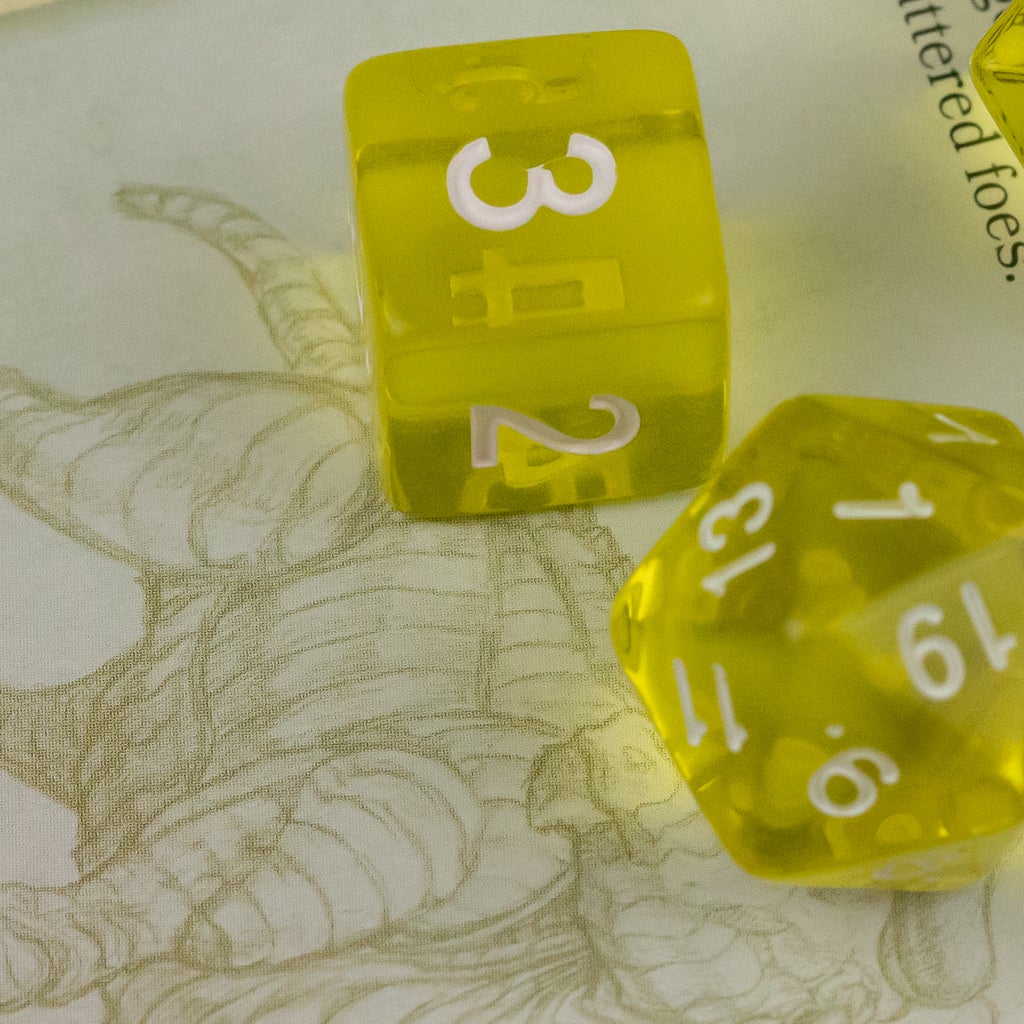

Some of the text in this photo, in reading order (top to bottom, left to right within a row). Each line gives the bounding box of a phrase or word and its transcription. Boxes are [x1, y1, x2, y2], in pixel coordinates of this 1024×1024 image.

[445, 131, 618, 232] 3
[469, 393, 641, 469] 2
[697, 480, 777, 598] 13
[832, 480, 935, 521] 1
[897, 580, 1018, 703] 19
[671, 656, 750, 754] 11
